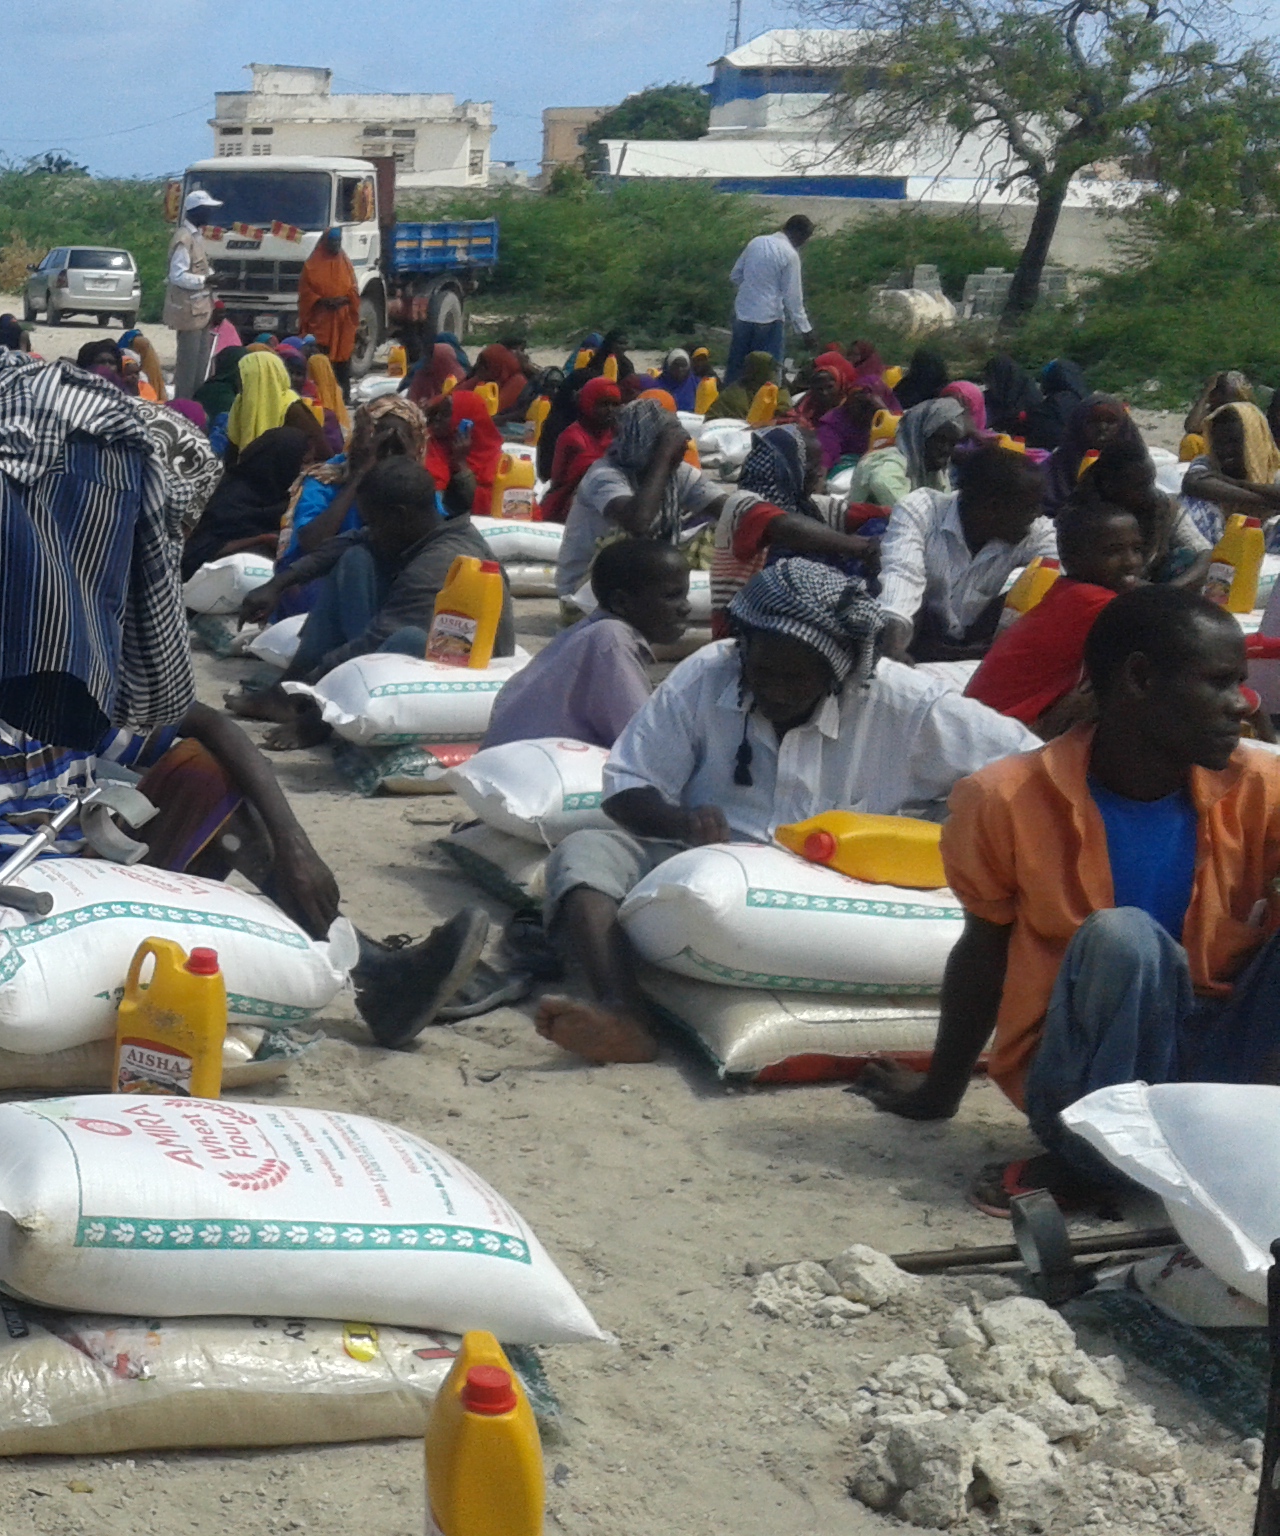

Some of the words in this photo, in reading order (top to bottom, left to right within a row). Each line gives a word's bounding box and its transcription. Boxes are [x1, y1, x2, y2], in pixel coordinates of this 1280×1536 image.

[127, 1048, 183, 1073] AISHA
[121, 1104, 204, 1170] AMIRA
[181, 1114, 231, 1160] Wheat
[216, 1119, 258, 1158] Flour
